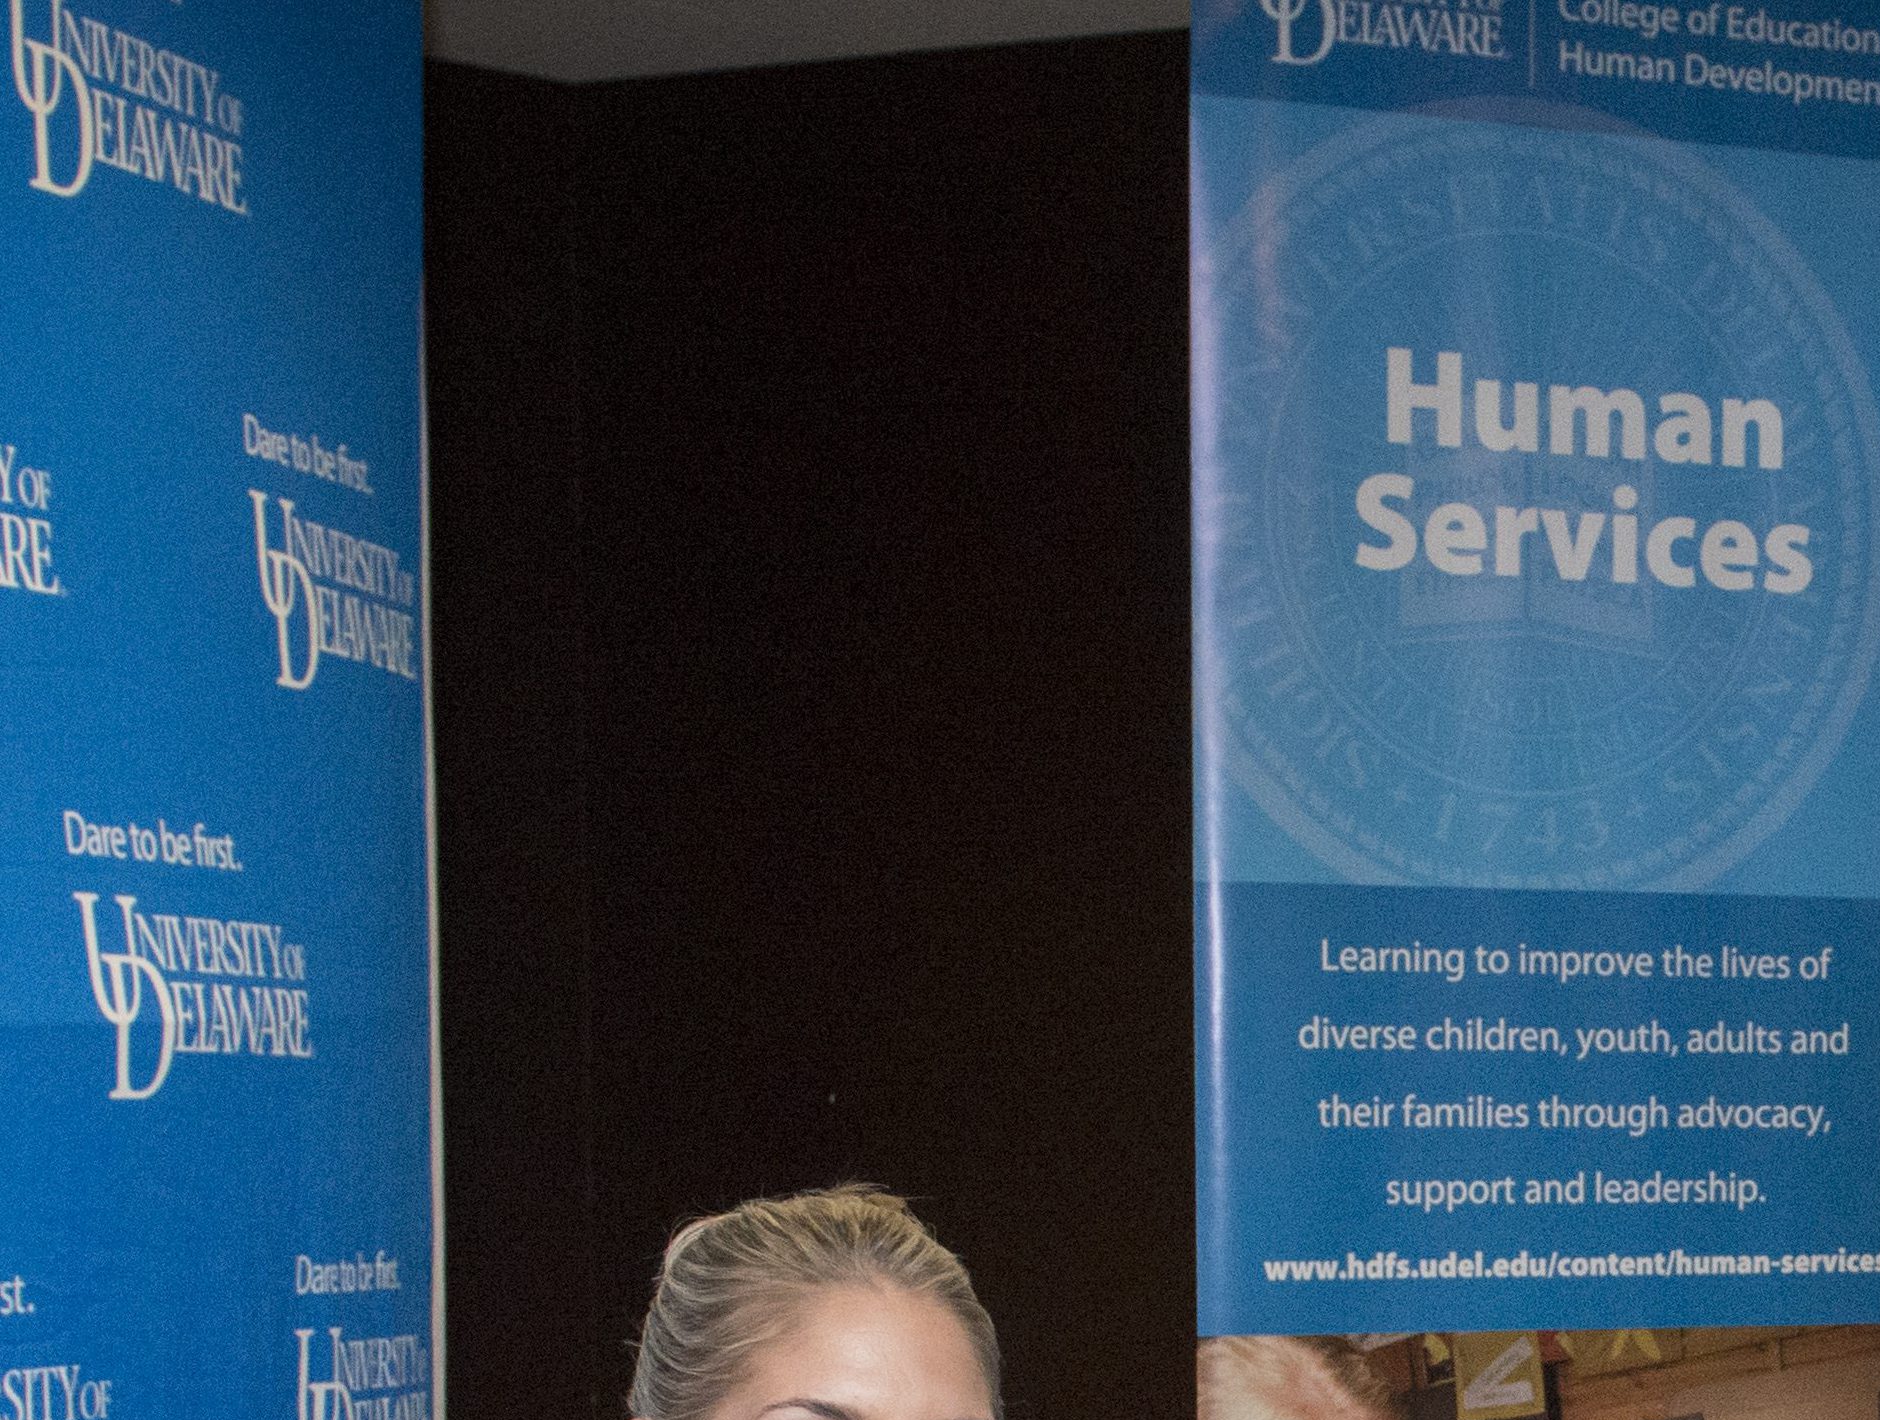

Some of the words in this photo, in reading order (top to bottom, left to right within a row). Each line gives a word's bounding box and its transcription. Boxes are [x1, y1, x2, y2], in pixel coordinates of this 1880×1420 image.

[1270, 0, 1504, 65] DELAWARE
[1559, 0, 1680, 38] College
[1687, 2, 1722, 36] of
[1727, 6, 1880, 54] Education
[10, 0, 219, 124] UNIVERSITY
[1559, 40, 1676, 83] Human
[24, 37, 248, 214] DELAWARE
[1387, 347, 1784, 470] Human
[243, 413, 289, 467] Dare
[290, 434, 311, 473] to
[312, 435, 336, 482] be
[18, 466, 51, 510] OF
[248, 489, 400, 617] UNIVERSITY
[1356, 474, 1813, 595] Services
[266, 549, 418, 691] DELAWARE
[63, 809, 127, 860] Dare
[128, 822, 157, 863] to
[158, 818, 192, 867] be
[193, 822, 244, 873] first.
[73, 891, 282, 1025] UNIVERSITY
[1319, 937, 1466, 984] Learning
[1473, 944, 1511, 976] to
[1518, 942, 1655, 984] improve
[1661, 944, 1714, 979] the
[1721, 945, 1792, 980] lives
[1798, 946, 1833, 981] of
[100, 952, 314, 1101] DELAWARE
[1297, 1014, 1418, 1052] diverse
[1423, 1016, 1568, 1056] children,
[1575, 1019, 1679, 1061] youth,
[1686, 1020, 1783, 1055] adults
[1789, 1022, 1850, 1055] and
[1316, 1092, 1396, 1129] their
[1400, 1092, 1531, 1130] families
[1536, 1094, 1670, 1138] through
[1676, 1095, 1832, 1138] advocacy,
[1385, 1176, 1516, 1214] support
[1523, 1170, 1586, 1205] and
[1594, 1170, 1766, 1211] leadership.
[294, 1254, 339, 1296] Dare
[339, 1258, 356, 1293] to
[357, 1251, 374, 1293] be
[80, 1380, 112, 1420] OF
